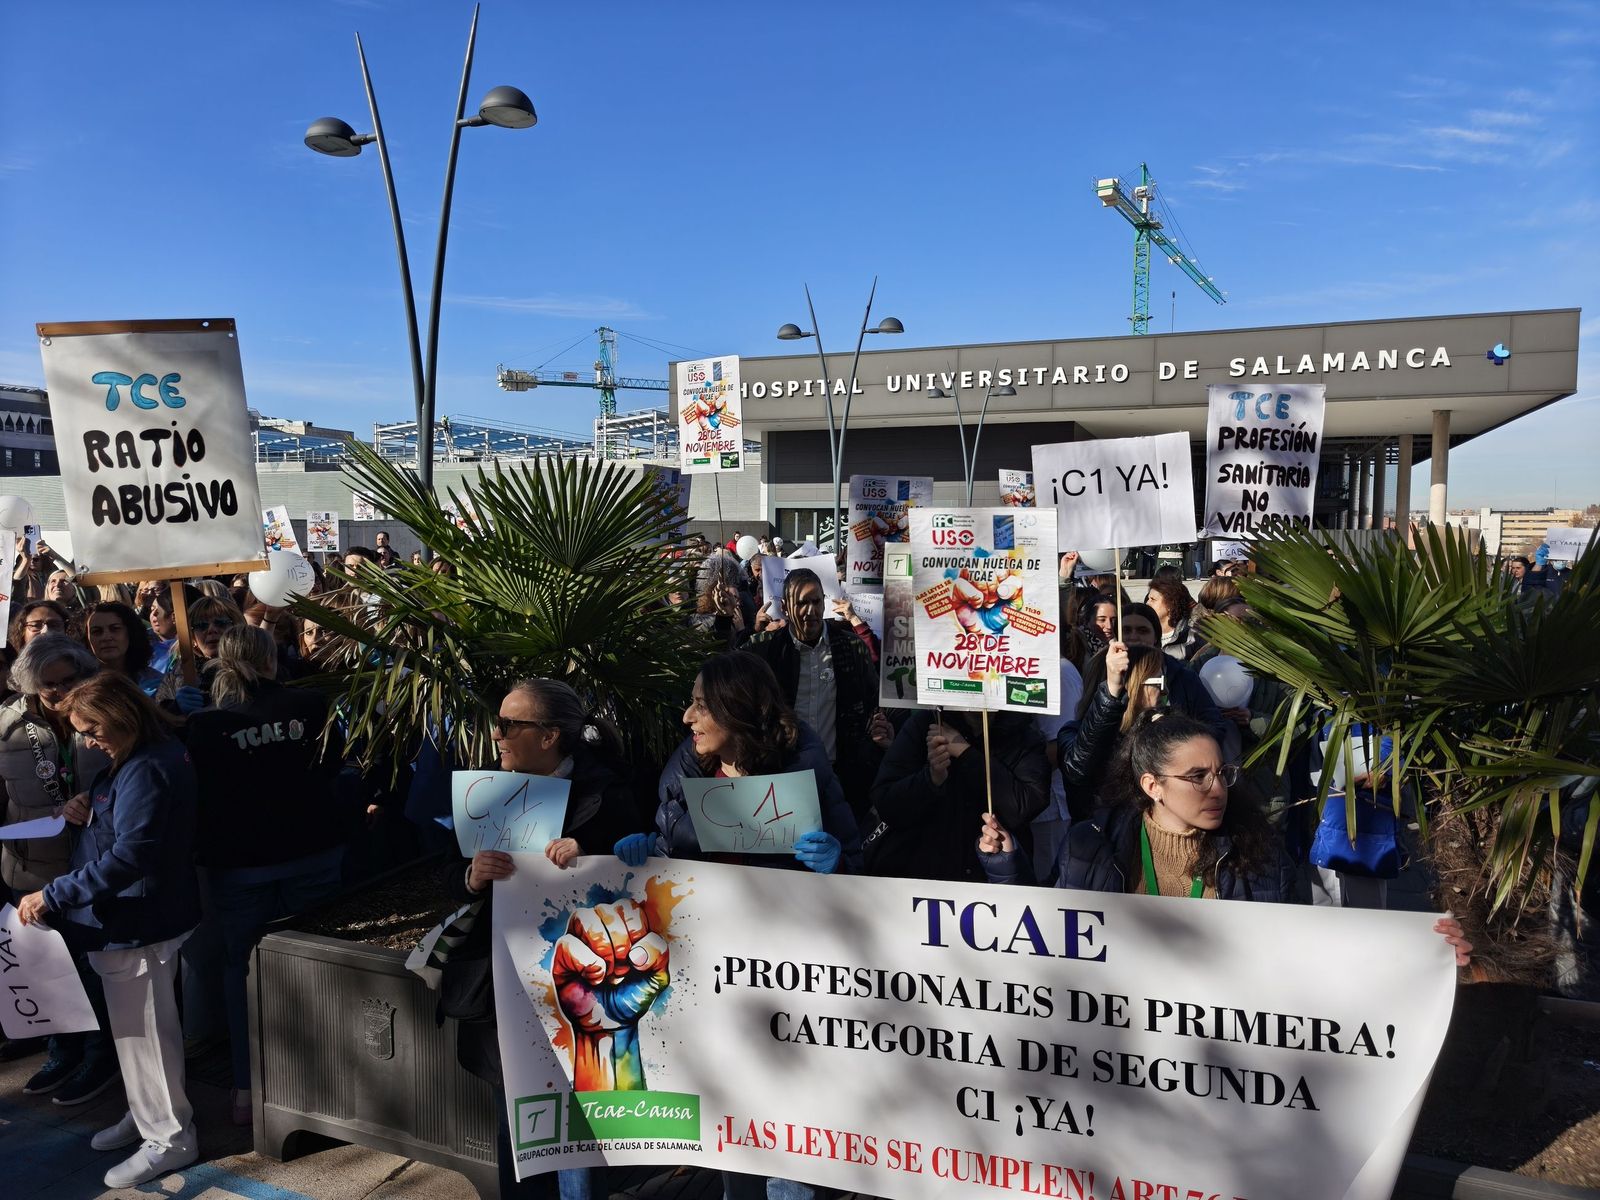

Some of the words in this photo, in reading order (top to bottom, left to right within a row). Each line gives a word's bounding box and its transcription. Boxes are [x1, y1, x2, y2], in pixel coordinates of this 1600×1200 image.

[688, 372, 705, 382] USO
[741, 378, 864, 398] HOSPITAL
[886, 364, 1130, 392] UNIVERSITARIO
[1158, 361, 1199, 380] DE
[1229, 347, 1452, 377] SALAMANCA
[92, 372, 187, 411] TCE
[1228, 391, 1291, 421] TCE
[84, 421, 206, 473] RATIO
[686, 441, 735, 453] NOVIEMBRE
[698, 431, 708, 441] 28
[710, 430, 722, 440] DE
[1218, 422, 1317, 454] PROFESIÓN
[1052, 468, 1103, 504] ¡C1
[1116, 462, 1169, 492] YA!
[1218, 461, 1310, 488] SANITARIA
[92, 473, 238, 527] ABUSIVO
[863, 488, 887, 498] USO
[1241, 490, 1269, 511] NO
[856, 504, 888, 512] CONVOCAN
[932, 530, 975, 546] USO
[853, 561, 883, 573] NOVI
[894, 559, 903, 570] T
[922, 557, 979, 569] CONVOCAN
[983, 559, 1023, 571] HUELGA
[1027, 559, 1041, 571] DE
[969, 571, 993, 582] TCAE
[955, 634, 978, 651] 28
[984, 635, 1010, 652] DE
[927, 652, 1040, 677] NOVIEMBRE
[231, 722, 285, 749] TCAE
[912, 897, 1107, 963] TCAE
[714, 956, 1054, 1018] ¡PROFESIONALES
[1067, 989, 1131, 1029] DE
[1144, 998, 1396, 1059] PRIMERA!
[770, 1012, 1005, 1068] CATEGORIA
[1017, 1038, 1079, 1079] DE
[1092, 1049, 1320, 1111] SEGUNDA
[528, 1108, 547, 1133] T
[583, 1100, 693, 1120] Tcae-Causa
[1015, 1095, 1095, 1137] ¡YA!
[563, 1145, 574, 1154] DE
[577, 1143, 595, 1153] TCAE
[598, 1142, 613, 1152] DEL
[614, 1141, 641, 1151] CAUSA
[644, 1141, 655, 1150] DE
[656, 1141, 703, 1152] SALAMANCA
[717, 1116, 776, 1153] ¡LAS
[784, 1123, 877, 1166] LEYES
[887, 1139, 923, 1174] SE
[932, 1147, 1095, 1200] CUMPLEN!
